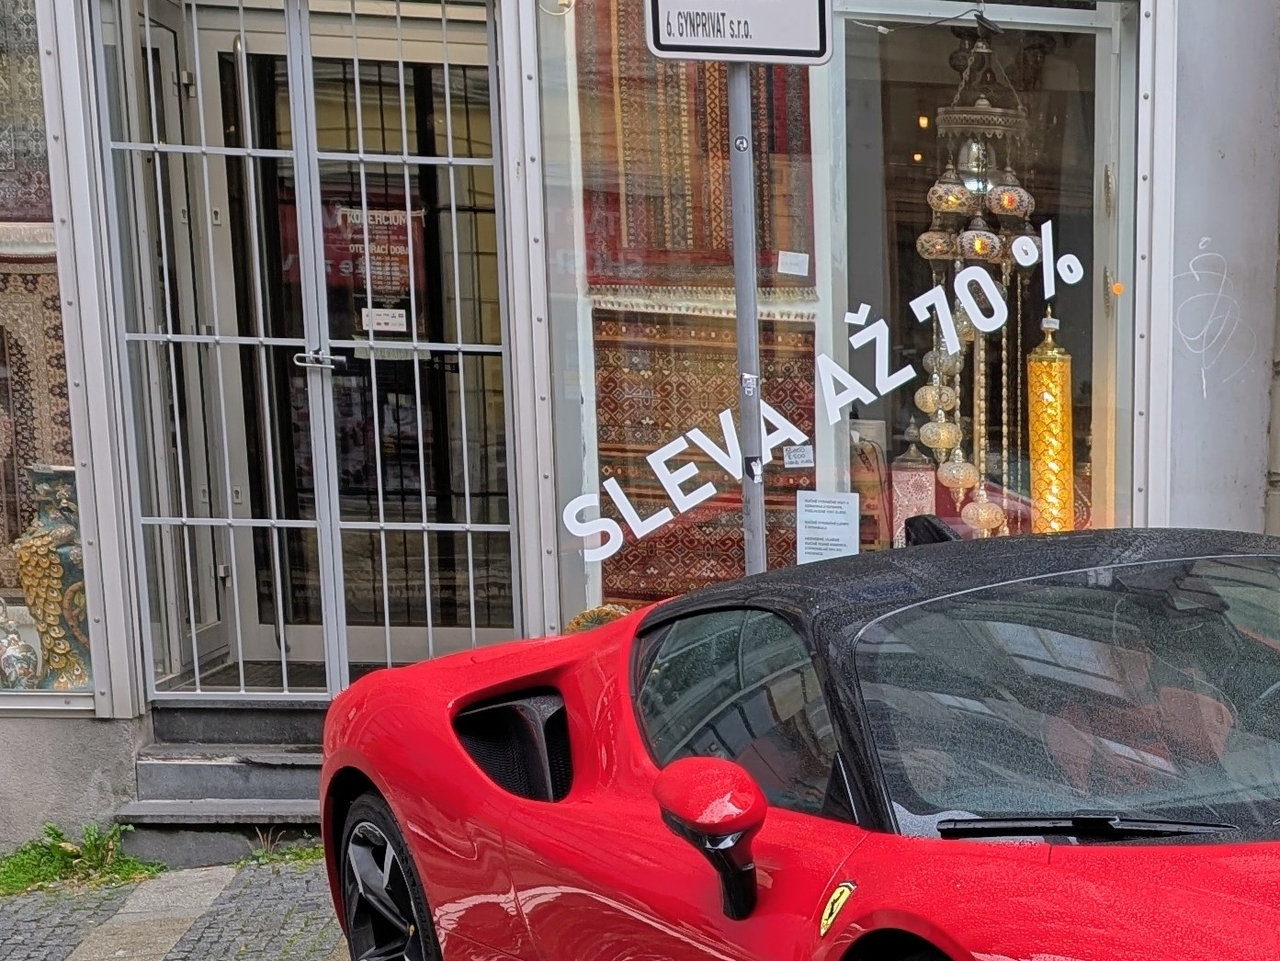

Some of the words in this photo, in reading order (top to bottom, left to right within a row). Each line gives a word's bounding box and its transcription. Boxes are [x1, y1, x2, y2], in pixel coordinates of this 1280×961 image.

[666, 10, 675, 38] 6.
[677, 11, 726, 39] GYNPRIVAT
[729, 19, 752, 39] s.r.o.
[562, 400, 809, 562] SLEVA
[815, 303, 917, 426] AŽ
[908, 265, 1009, 356] 70
